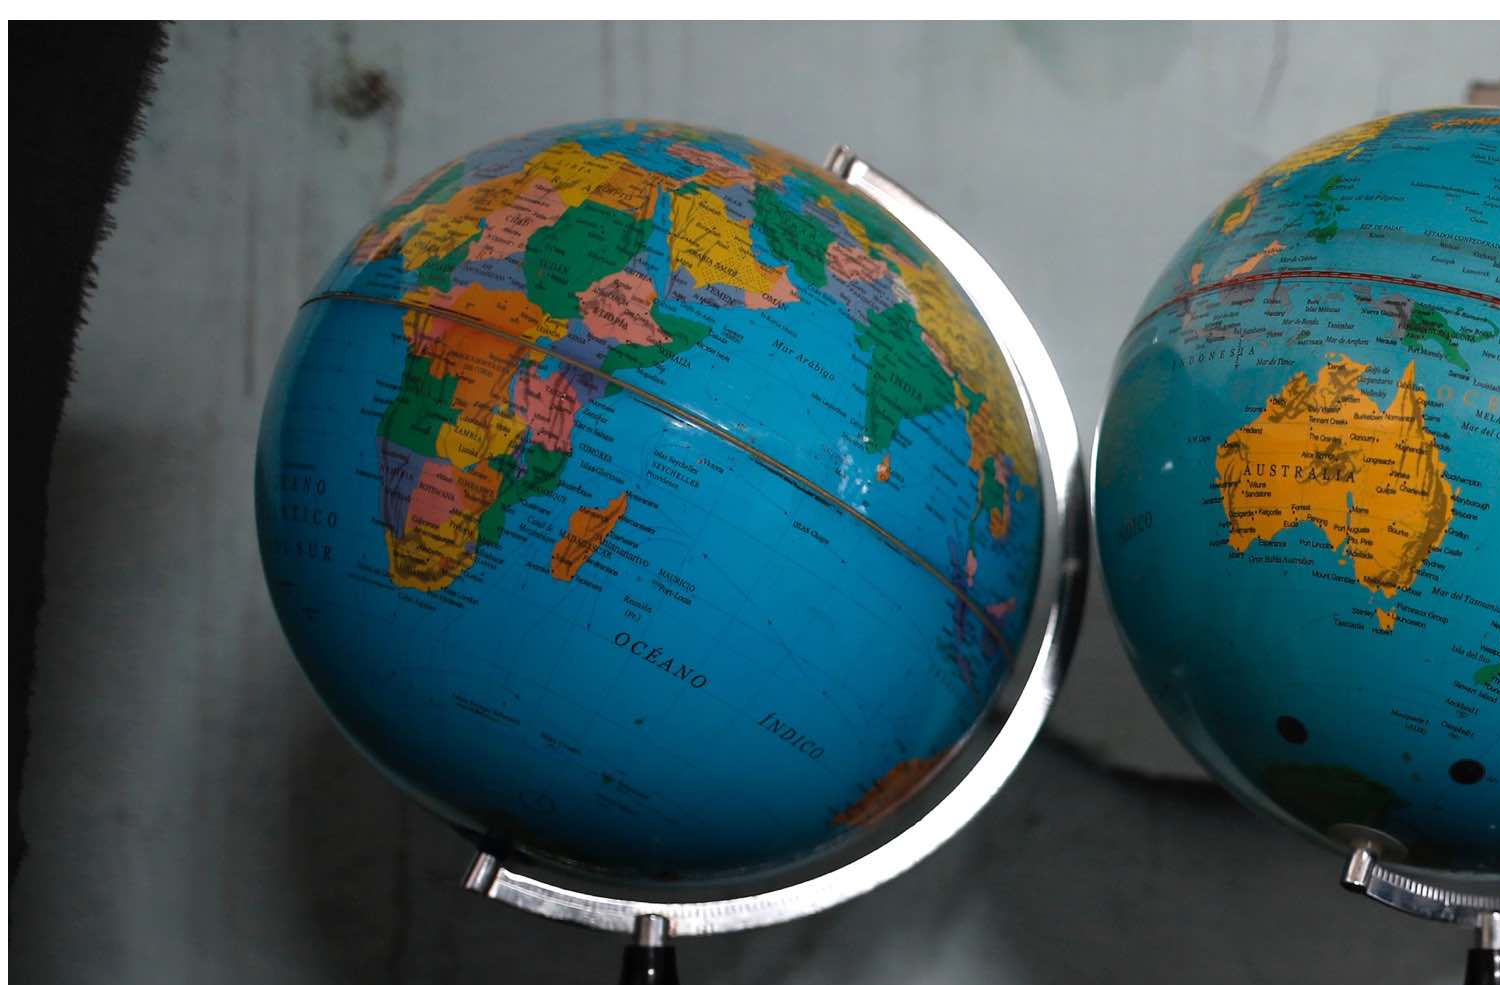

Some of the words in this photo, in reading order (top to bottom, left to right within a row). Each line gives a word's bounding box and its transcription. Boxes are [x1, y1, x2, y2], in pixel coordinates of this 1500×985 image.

[772, 337, 793, 356] Mar
[797, 353, 836, 381] Arábigo
[889, 372, 925, 403] INDIA
[1243, 463, 1357, 484] AUSTRALIA
[614, 631, 708, 690] OCÉANO
[758, 711, 826, 761] ÍNDICO
